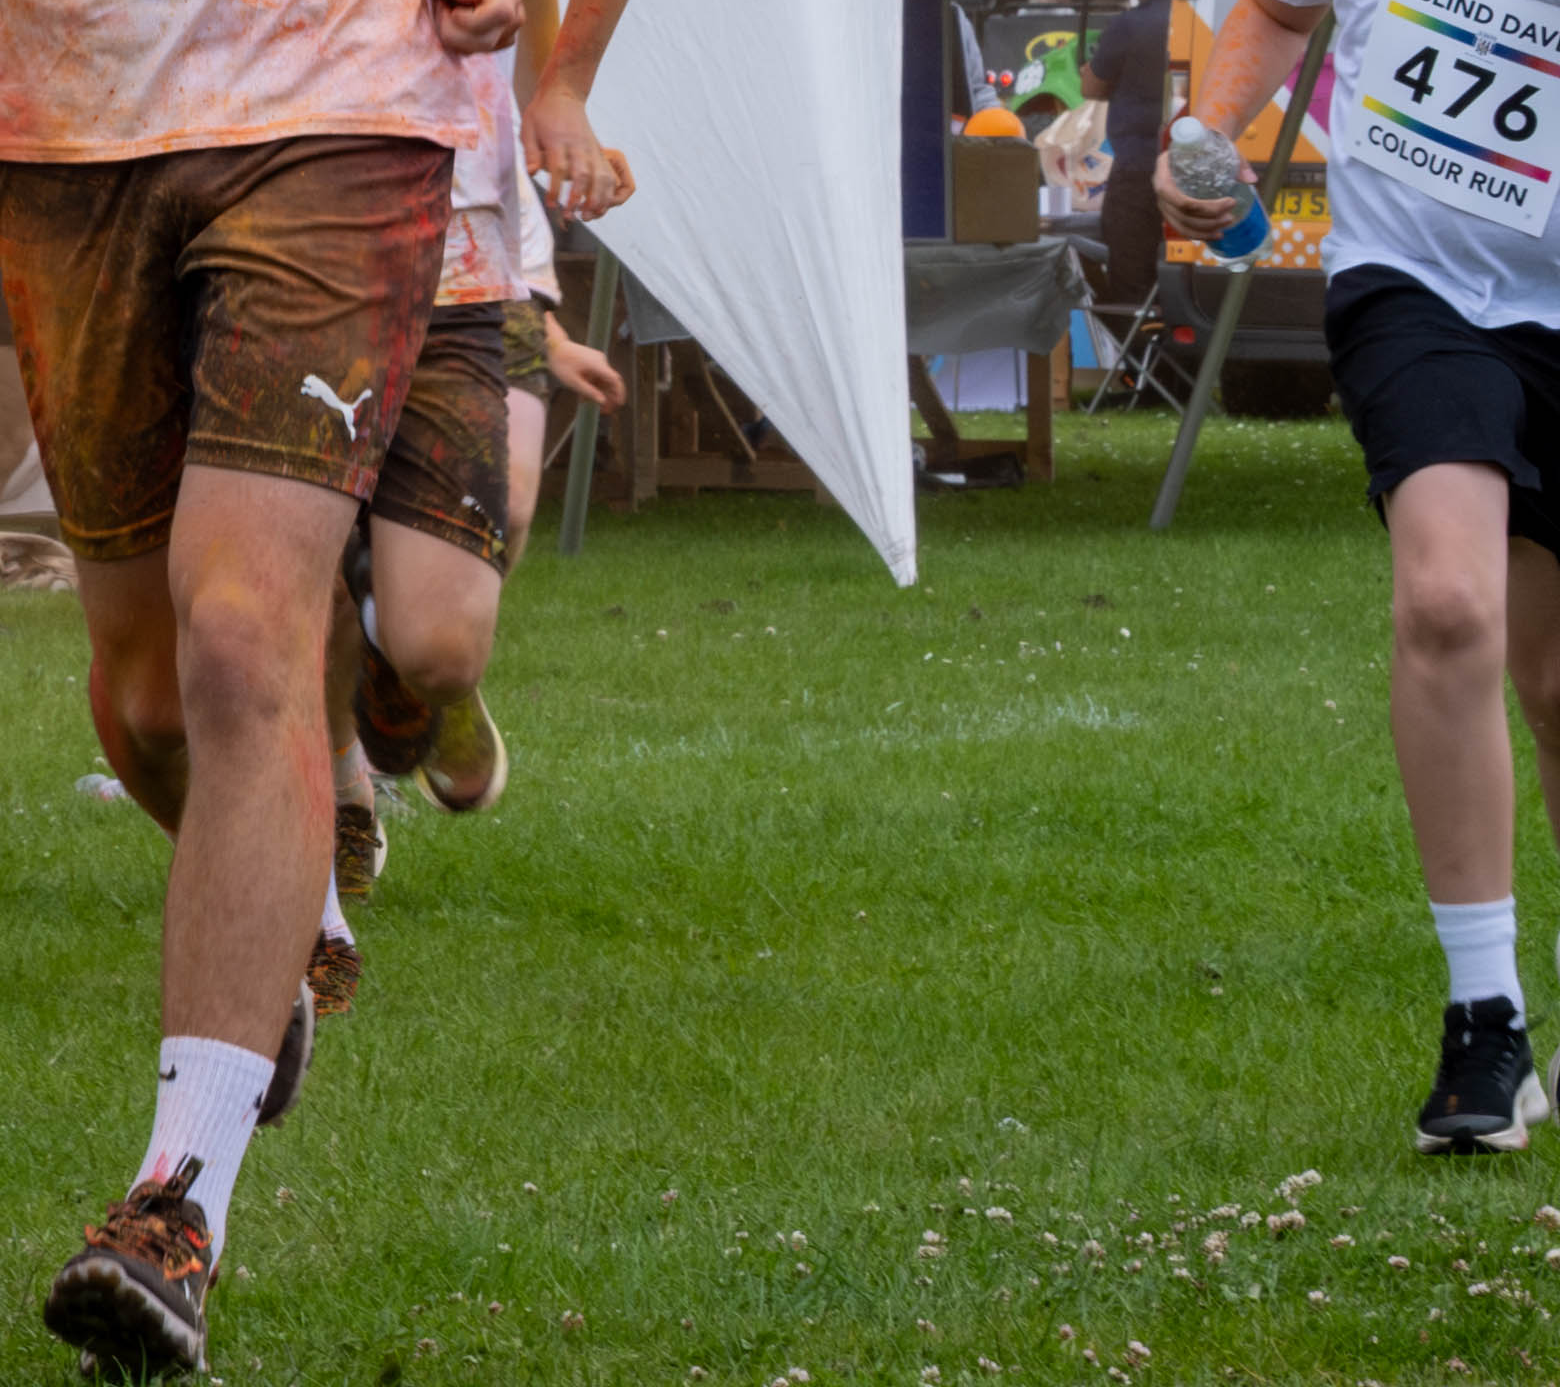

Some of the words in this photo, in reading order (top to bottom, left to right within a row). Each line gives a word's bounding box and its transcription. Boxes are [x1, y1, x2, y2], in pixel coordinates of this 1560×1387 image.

[1394, 45, 1542, 142] 476
[1367, 125, 1464, 184] COLOUR
[1469, 170, 1529, 207] RUN
